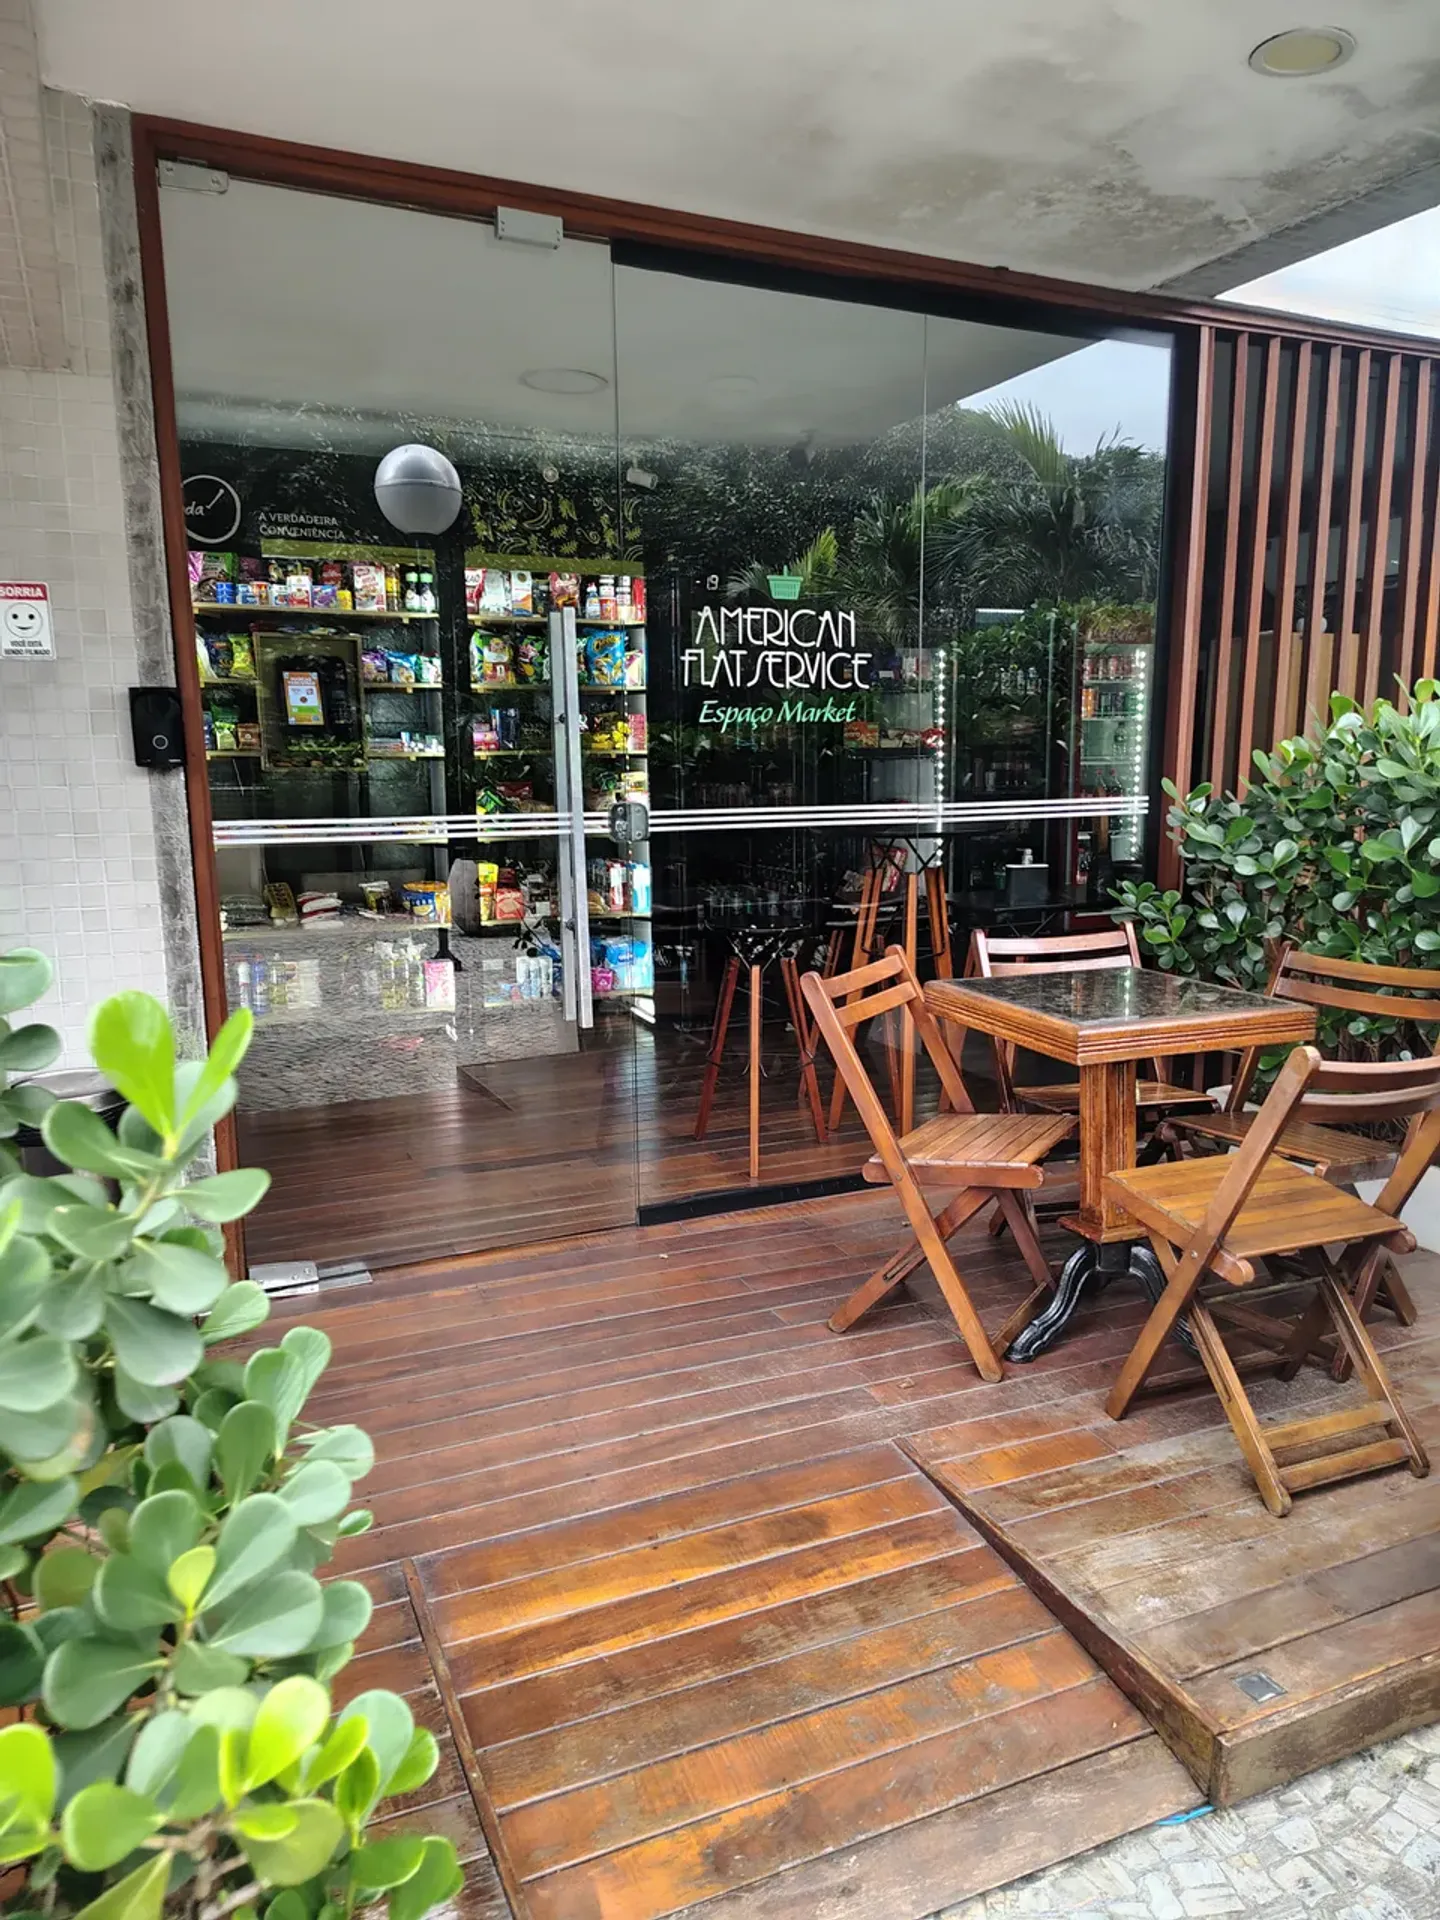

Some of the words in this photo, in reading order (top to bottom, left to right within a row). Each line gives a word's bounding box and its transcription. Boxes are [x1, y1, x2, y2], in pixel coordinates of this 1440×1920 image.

[258, 512, 268, 521] A
[269, 513, 339, 526] VERDADEIRA
[259, 524, 345, 539] CONVENIÊNCIA
[695, 605, 856, 648] AMERICAN
[680, 648, 748, 688] FLAT
[747, 651, 872, 689] SERVICE
[699, 700, 773, 734] Espaço
[776, 697, 856, 723] Market
